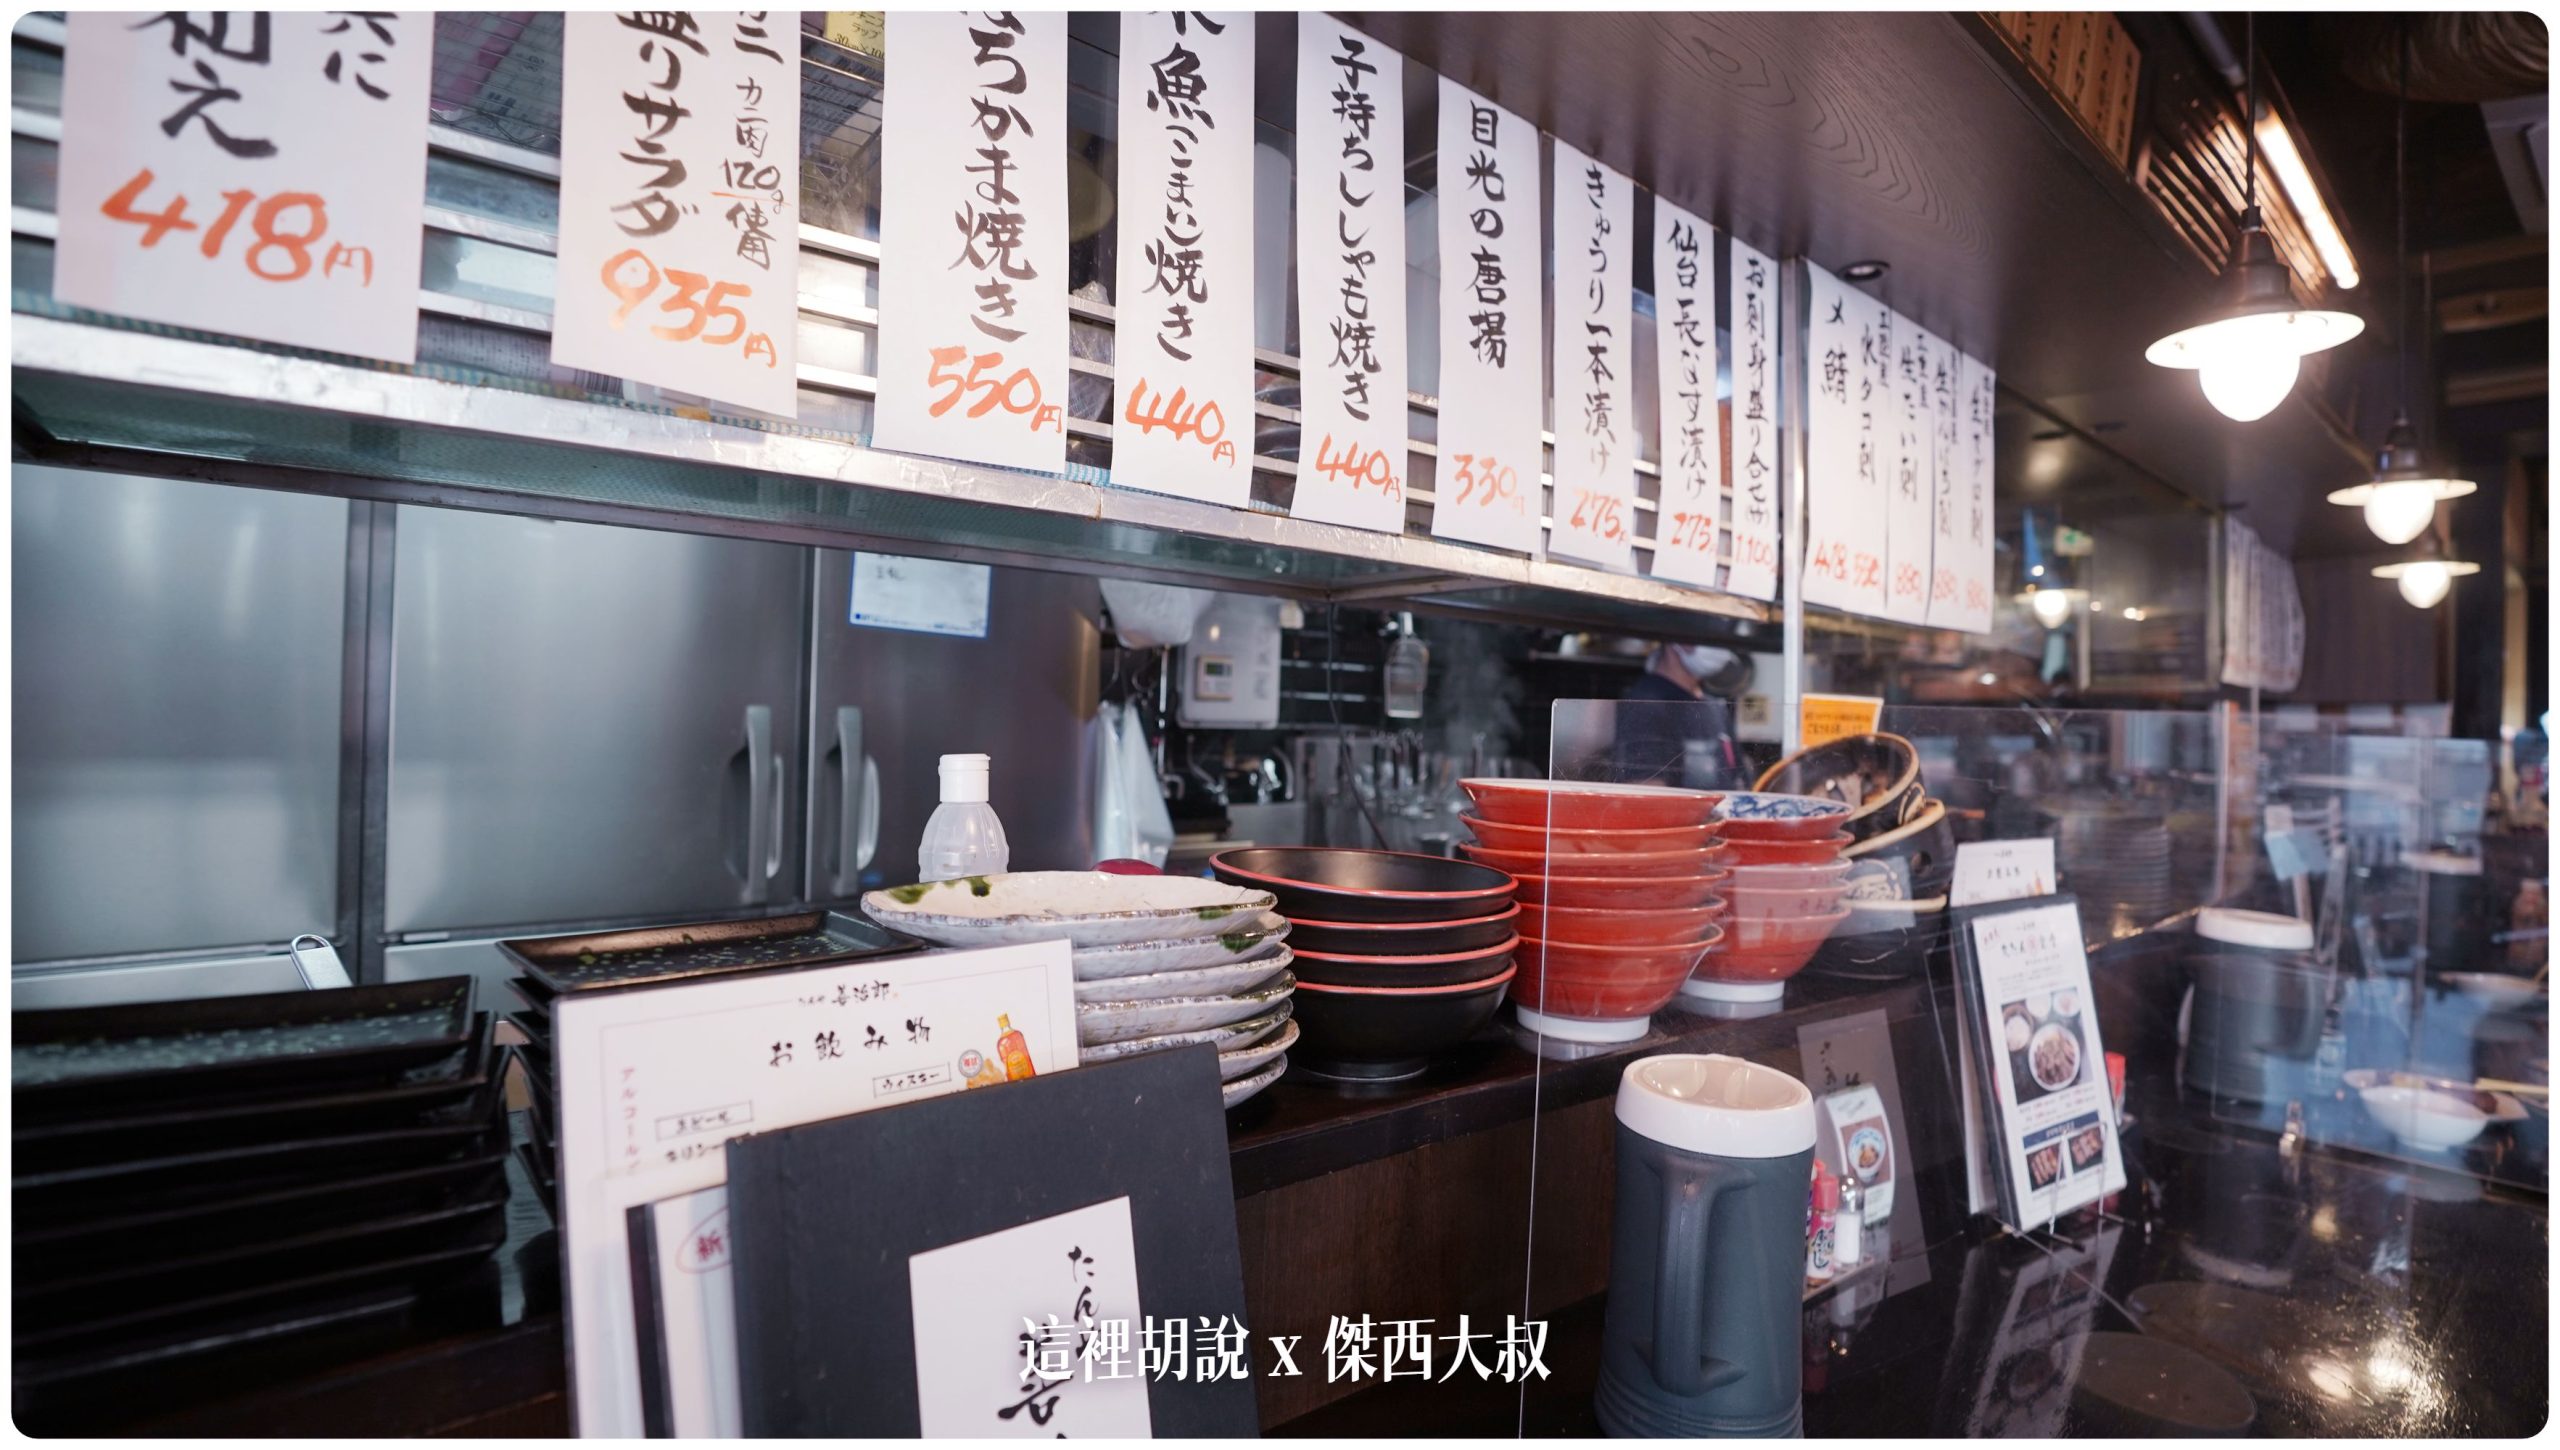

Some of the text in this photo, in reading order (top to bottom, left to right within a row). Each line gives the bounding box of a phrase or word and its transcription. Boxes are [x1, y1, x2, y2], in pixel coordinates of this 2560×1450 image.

[100, 168, 374, 288] 418円
[1328, 34, 1382, 422] 子持ちししゃも焼き
[1465, 100, 1508, 369] 目光の唐揚
[600, 248, 777, 369] 935円
[1585, 163, 1617, 475] きゅうり一本漬け
[1667, 219, 1707, 500] 仙台長なす漬け
[928, 346, 1062, 433] 550円
[1125, 378, 1236, 468] 440円
[1315, 434, 1401, 502] 440円
[770, 1016, 932, 1069] お飲み物
